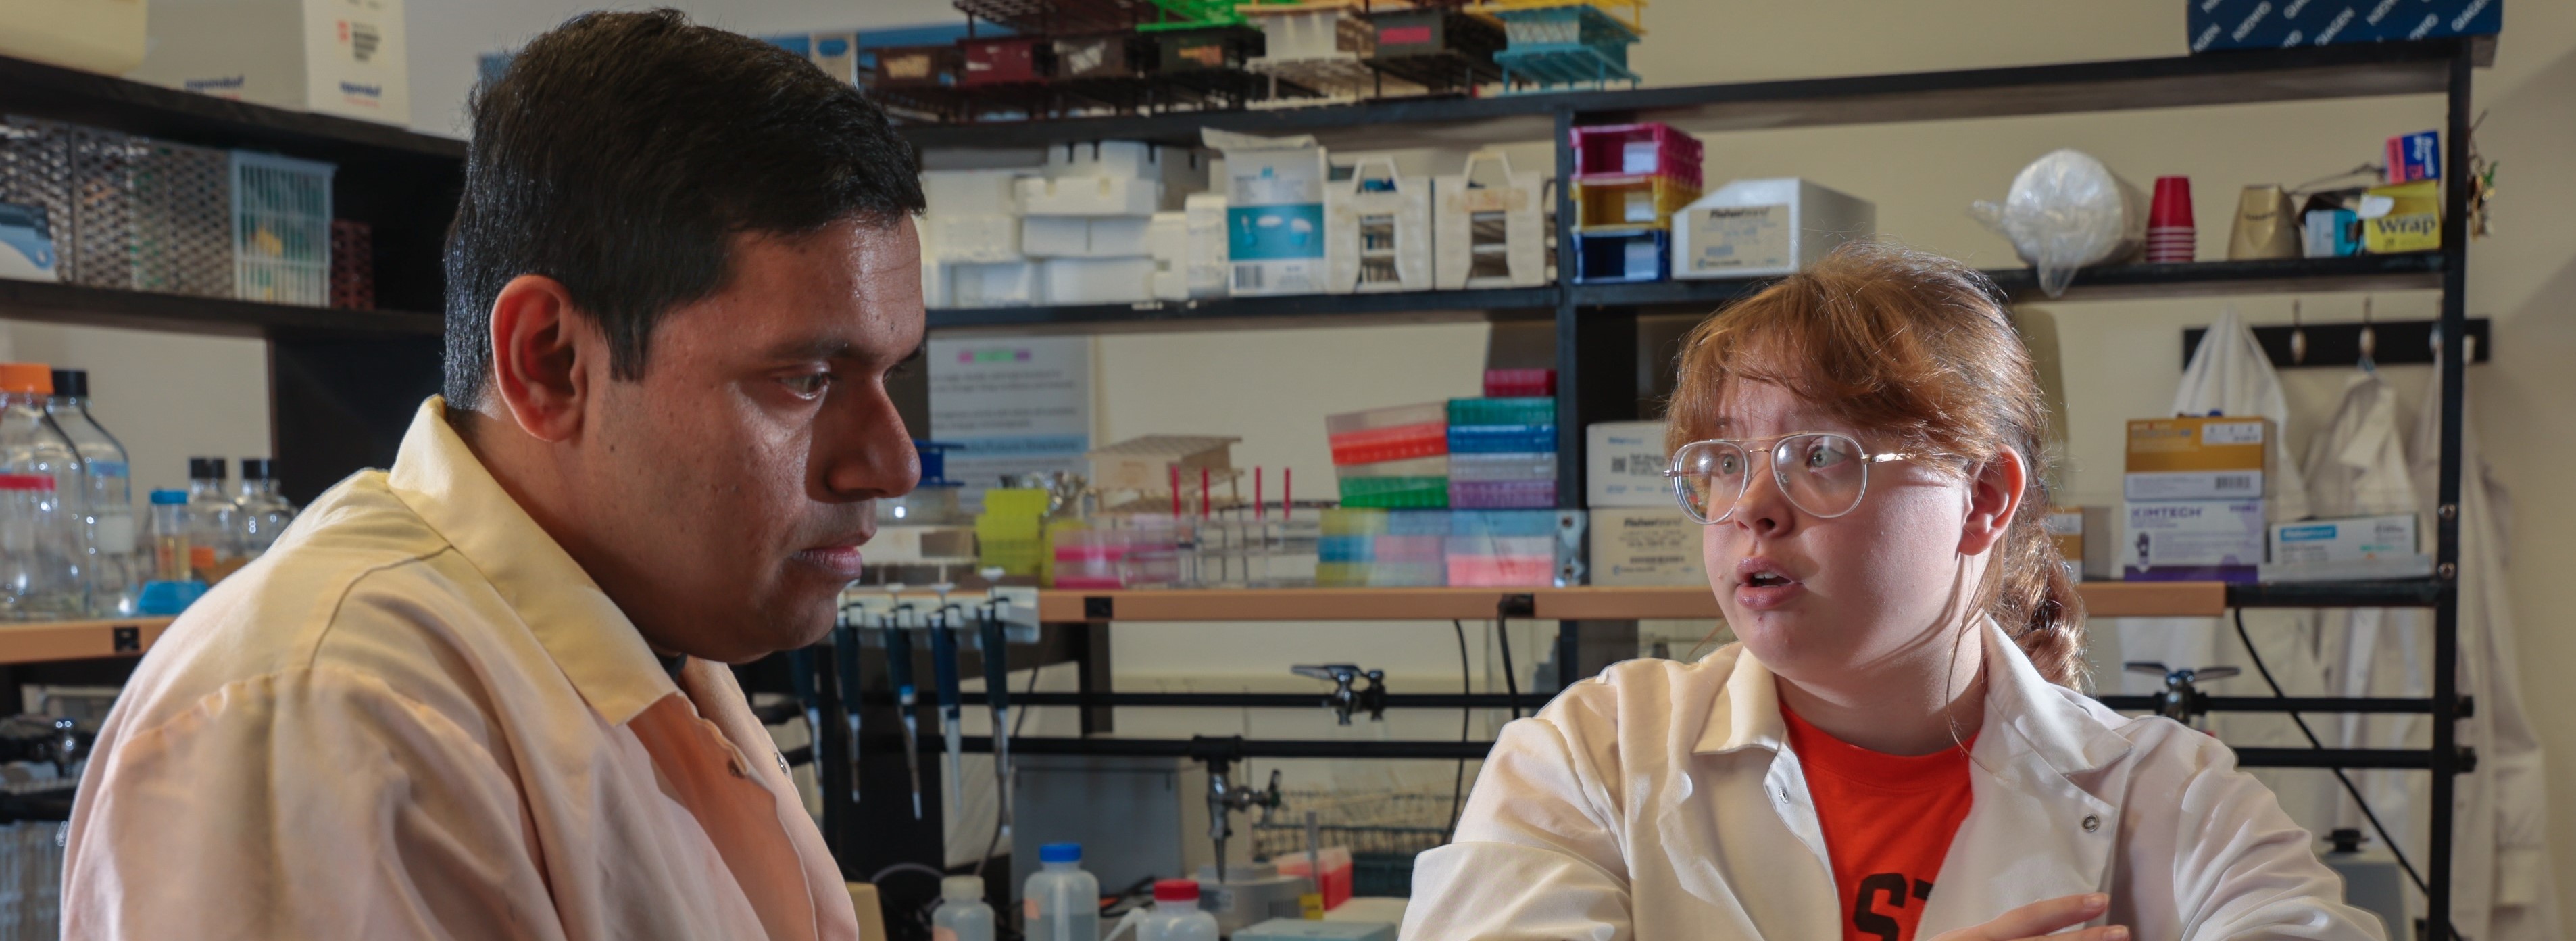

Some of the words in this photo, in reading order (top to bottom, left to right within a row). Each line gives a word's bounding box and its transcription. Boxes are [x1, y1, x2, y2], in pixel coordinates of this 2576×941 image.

[2232, 1, 2272, 43] QIAGEN
[2314, 6, 2355, 47] QIAGEN
[2376, 216, 2437, 237] Wrap
[2131, 506, 2202, 518] KIMTECH
[1853, 873, 1934, 941] S
